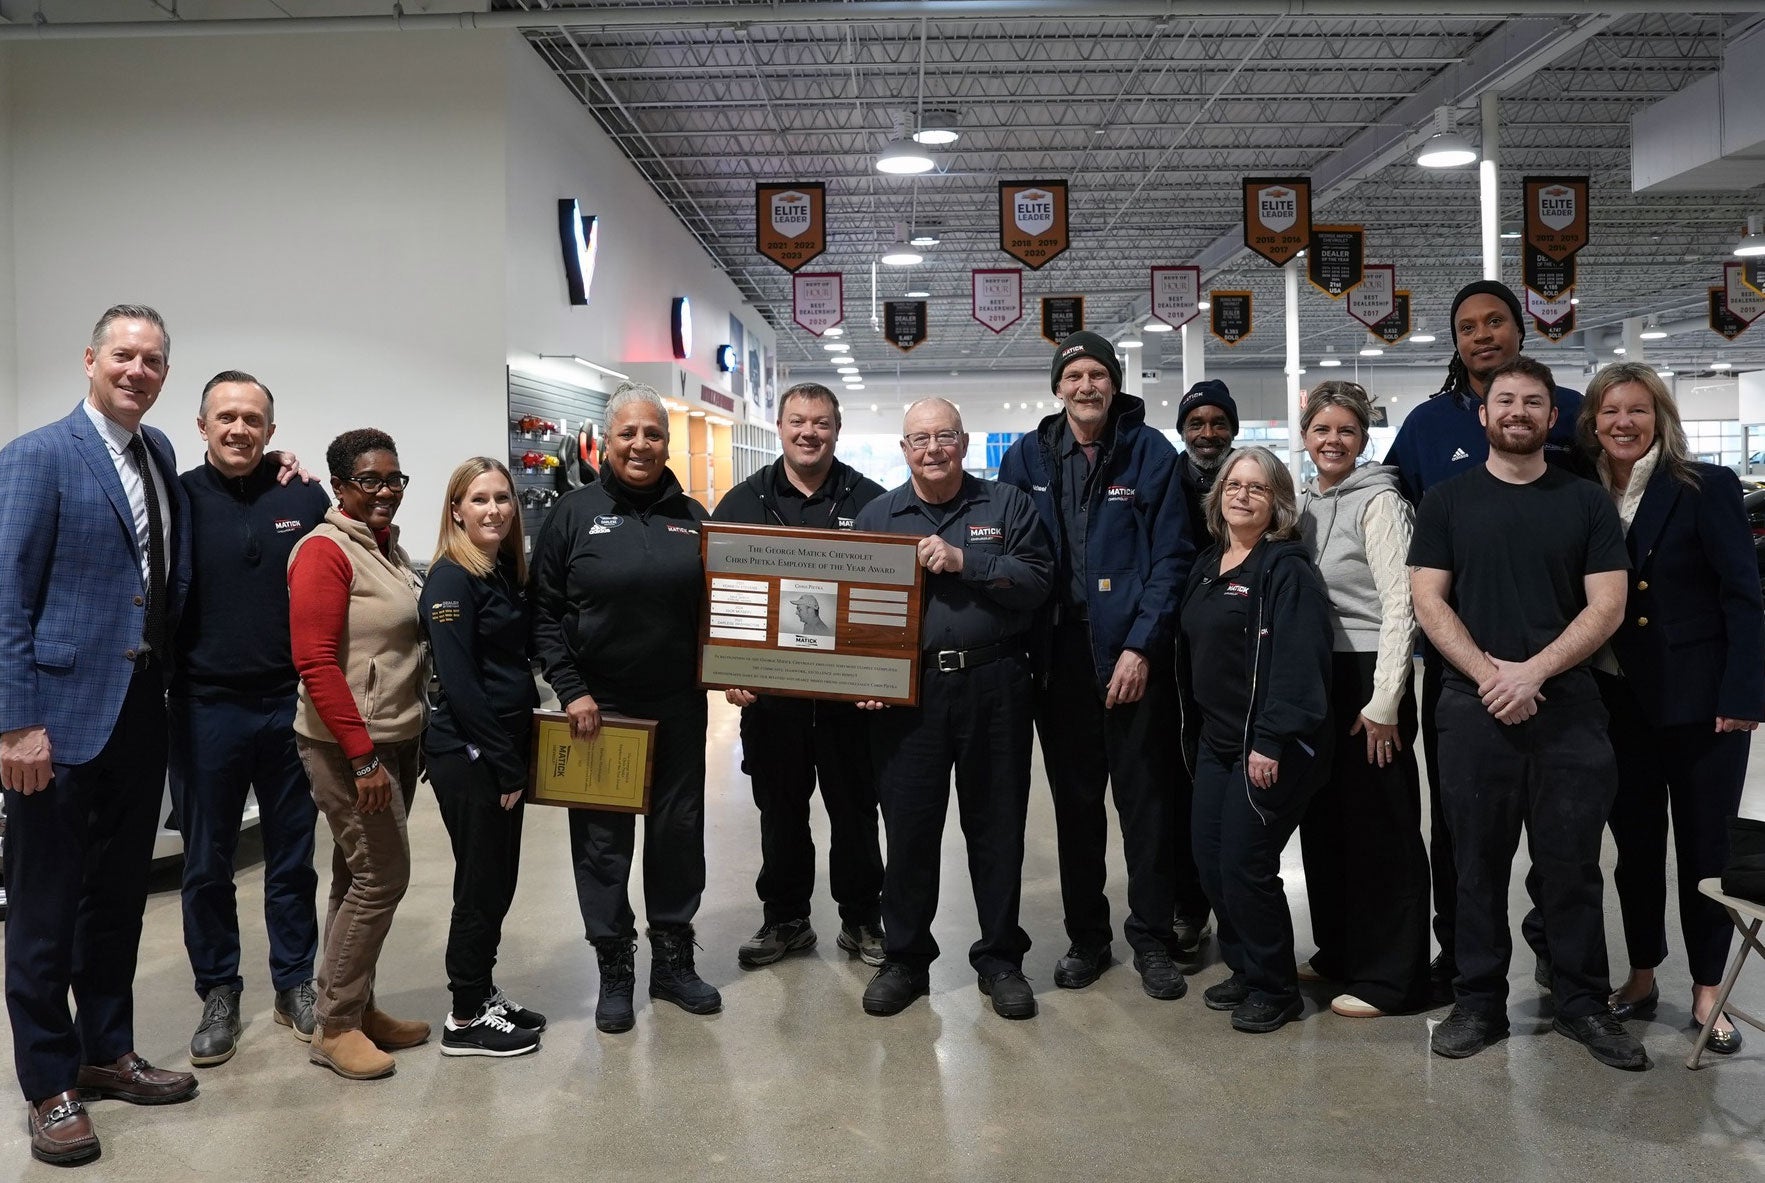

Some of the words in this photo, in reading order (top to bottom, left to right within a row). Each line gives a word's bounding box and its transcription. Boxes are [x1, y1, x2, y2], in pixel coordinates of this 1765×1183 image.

[1018, 204, 1050, 213] ELITE
[1262, 201, 1294, 210] ELITE
[1542, 200, 1572, 208] ELITE
[774, 206, 808, 216] ELITE
[1062, 346, 1084, 357] MATICK
[275, 520, 300, 529] MATICK
[970, 528, 1002, 536] MATICK
[748, 545, 762, 554] THE
[765, 546, 796, 556] GEORGE
[798, 548, 826, 558] MATICK
[828, 551, 873, 560] CHEVROLET
[726, 555, 748, 564] CHRIS
[750, 557, 776, 566] PIETKA
[778, 559, 816, 568] EMPLOYEE
[846, 564, 866, 572] YEAR
[867, 566, 896, 574] AWARD
[1227, 586, 1250, 594] MATICK
[558, 745, 566, 776] MATICK
